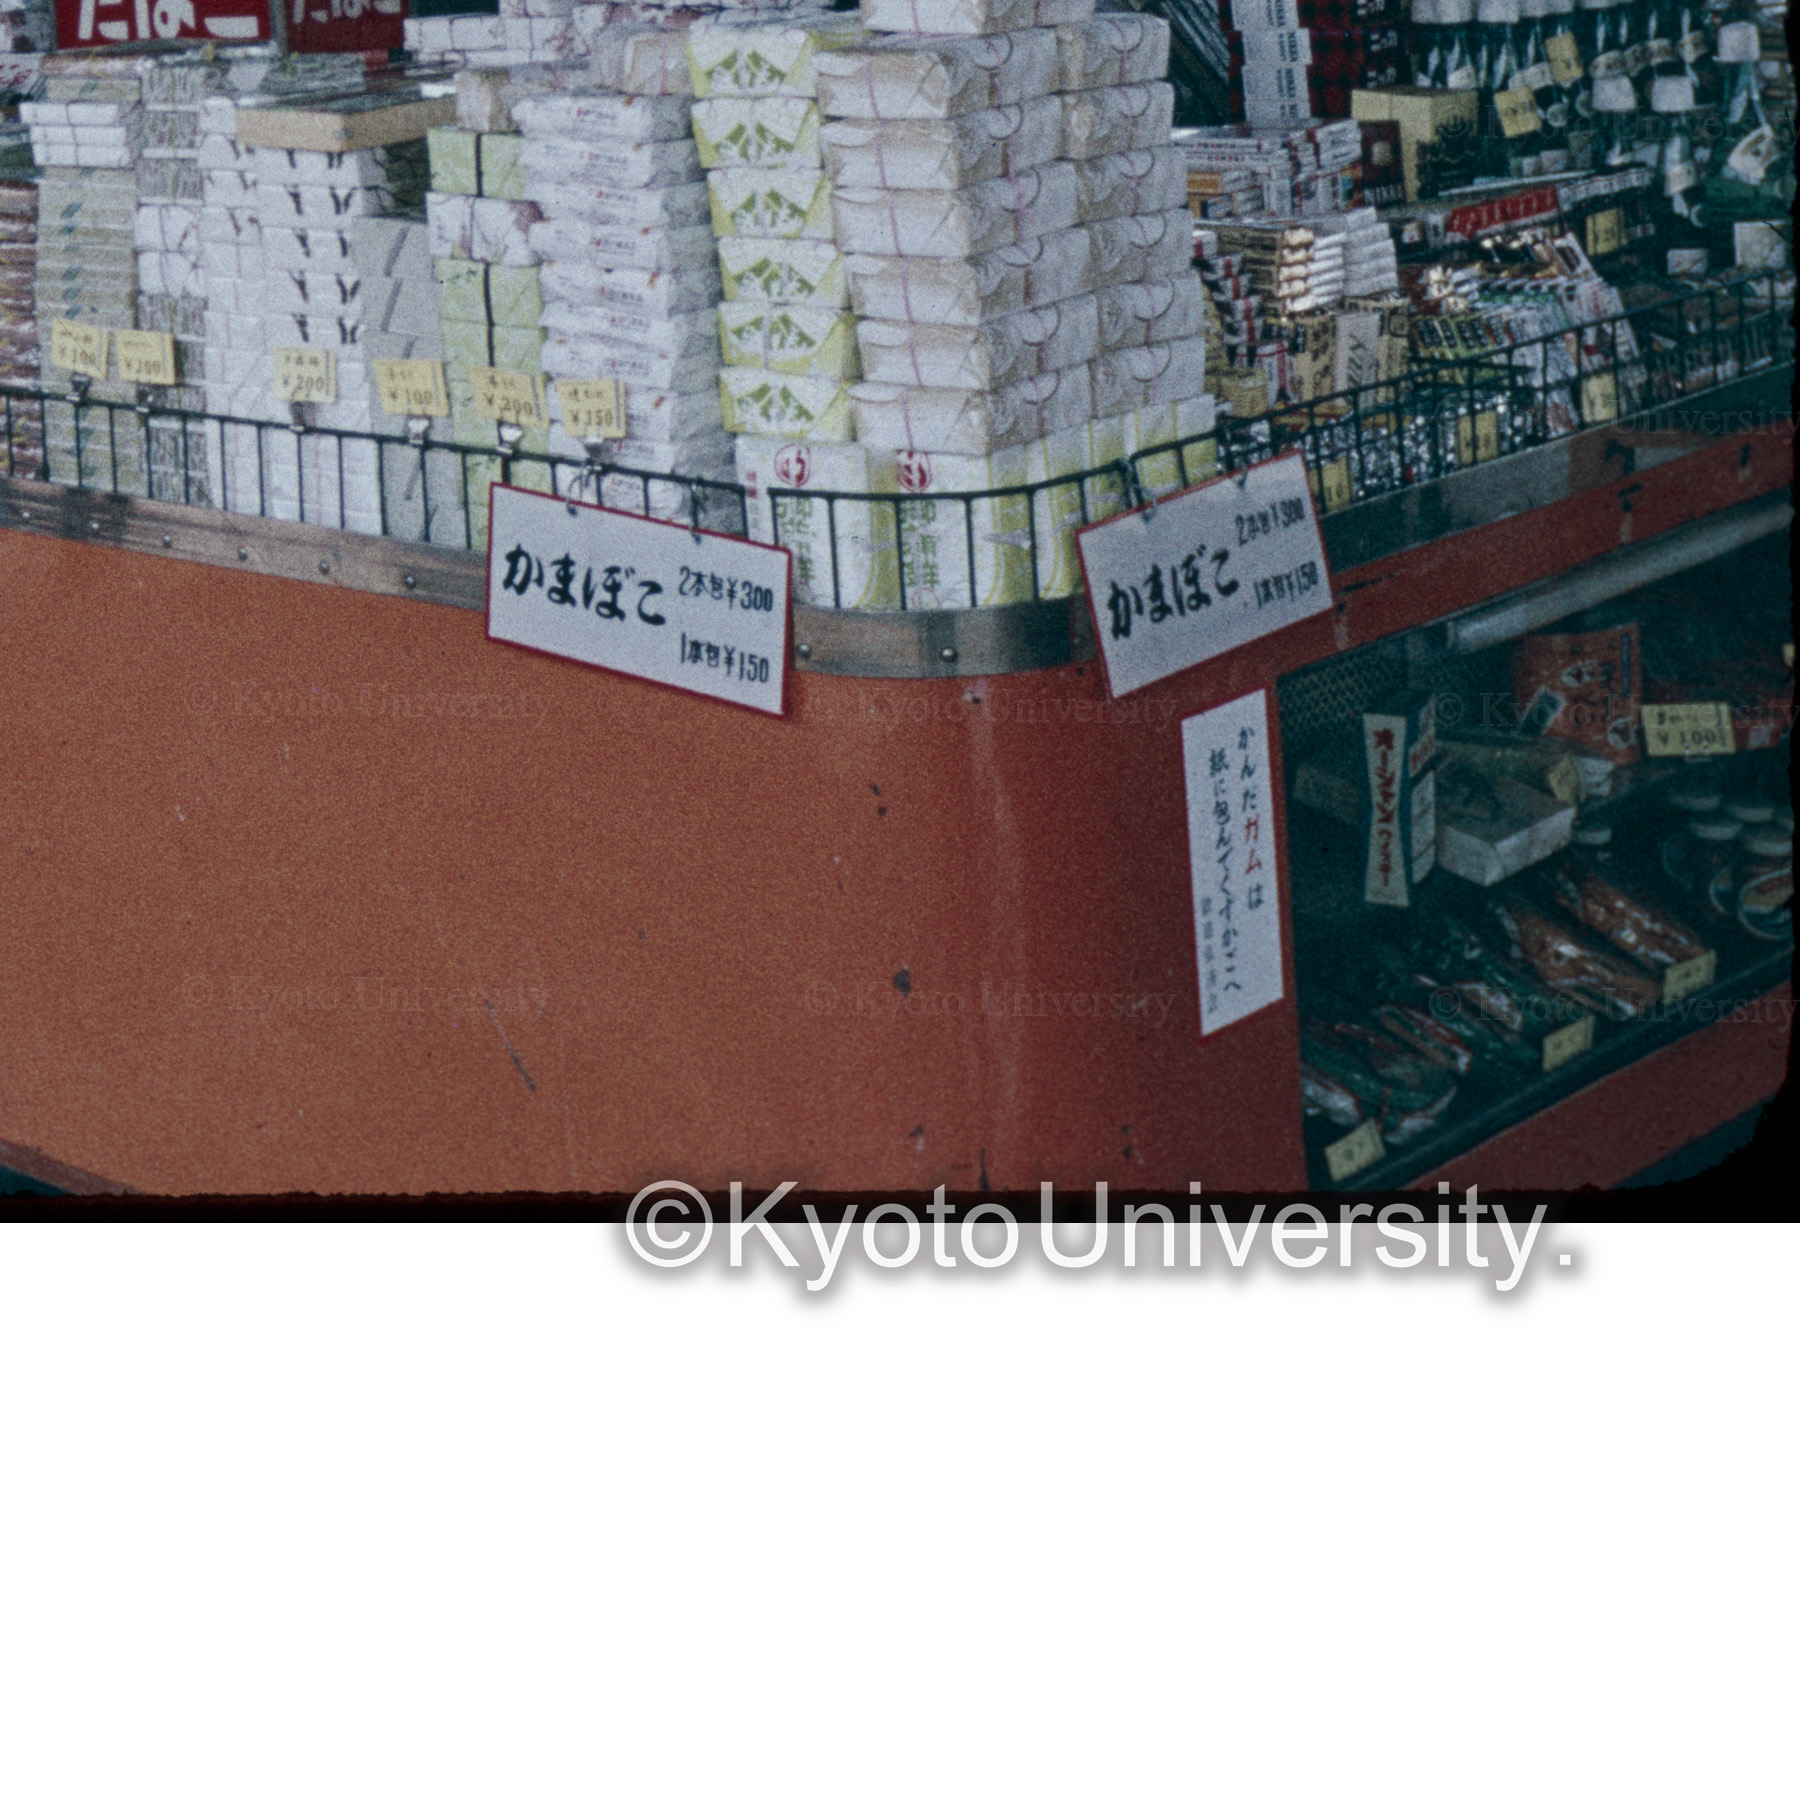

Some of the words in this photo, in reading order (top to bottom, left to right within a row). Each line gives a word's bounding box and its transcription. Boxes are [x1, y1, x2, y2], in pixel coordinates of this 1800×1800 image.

[501, 542, 668, 627] かまぼこ
[1106, 550, 1241, 640] かまぼこ
